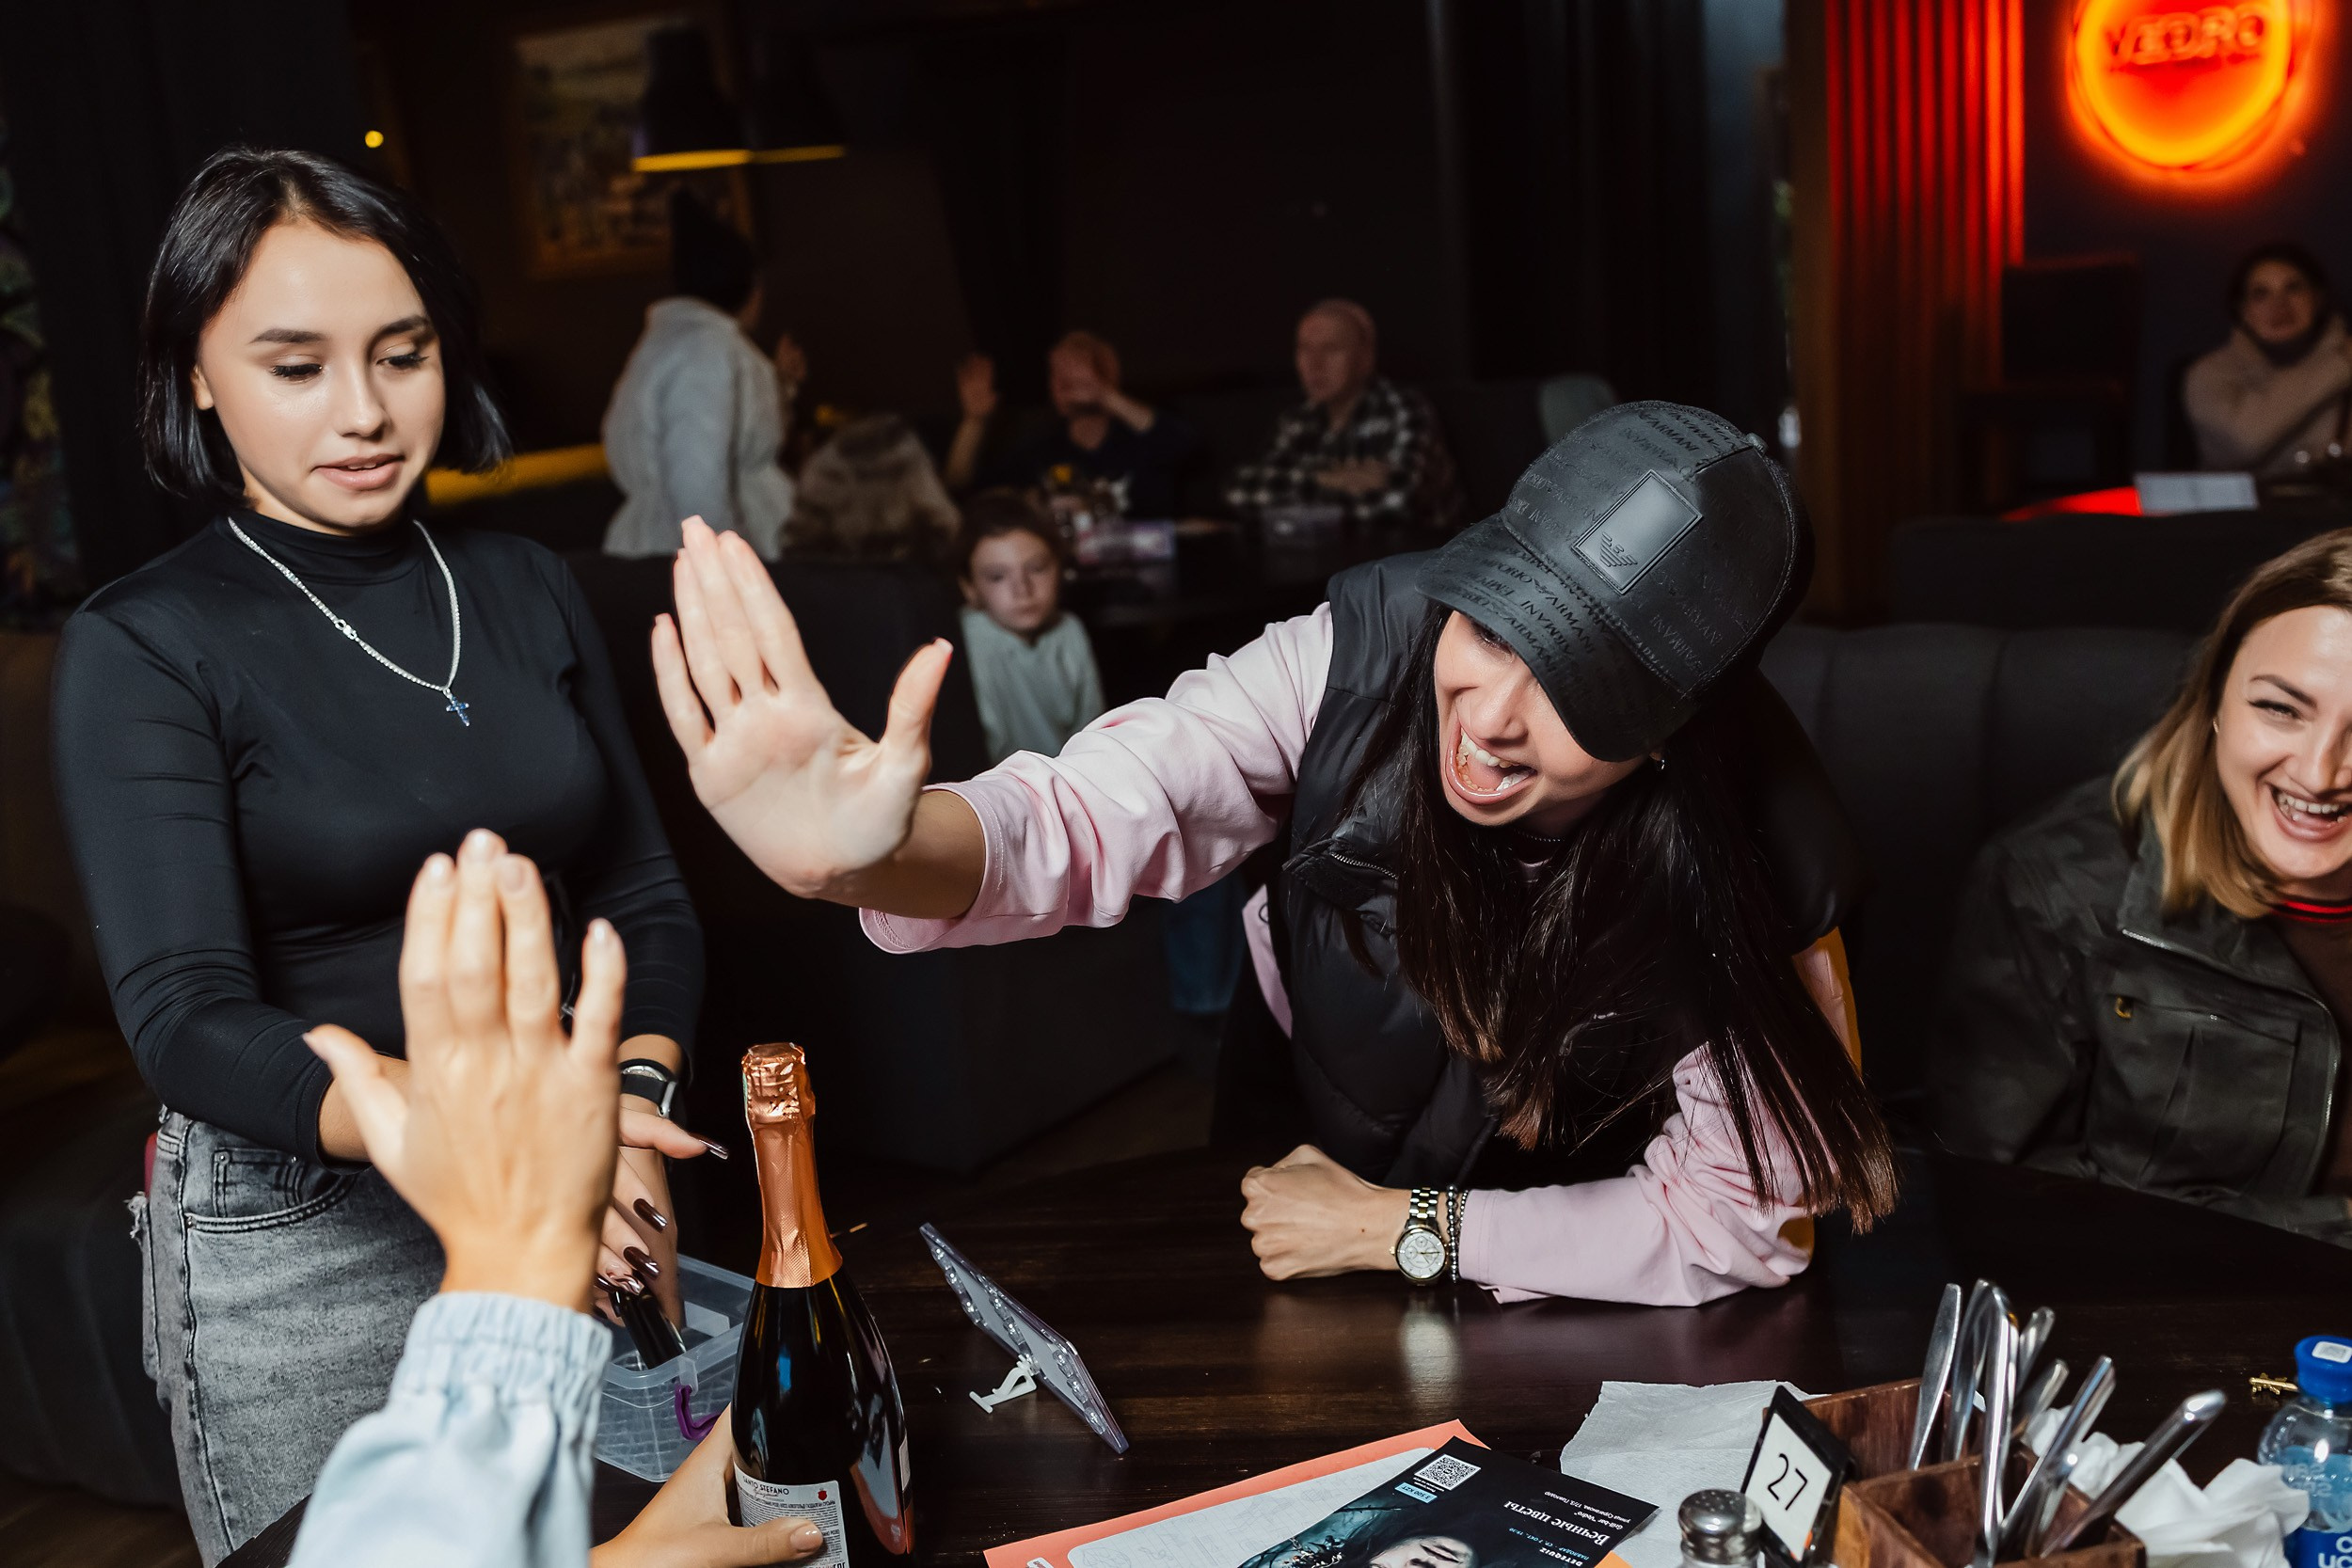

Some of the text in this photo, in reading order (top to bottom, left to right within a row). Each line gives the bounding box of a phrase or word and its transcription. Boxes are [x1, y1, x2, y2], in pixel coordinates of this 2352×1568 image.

[1546, 595, 1597, 655] ARMANI
[742, 1475, 759, 1489] SANTO
[759, 1483, 790, 1496] STEFANO
[1766, 1452, 1808, 1511] 27
[1503, 1500, 1610, 1546] Вечные цветы
[1597, 1518, 1624, 1530] Grill-bar
[1539, 1546, 1583, 1567] DETEQUIZ
[1558, 1546, 1590, 1560] ПАВЛОДАР
